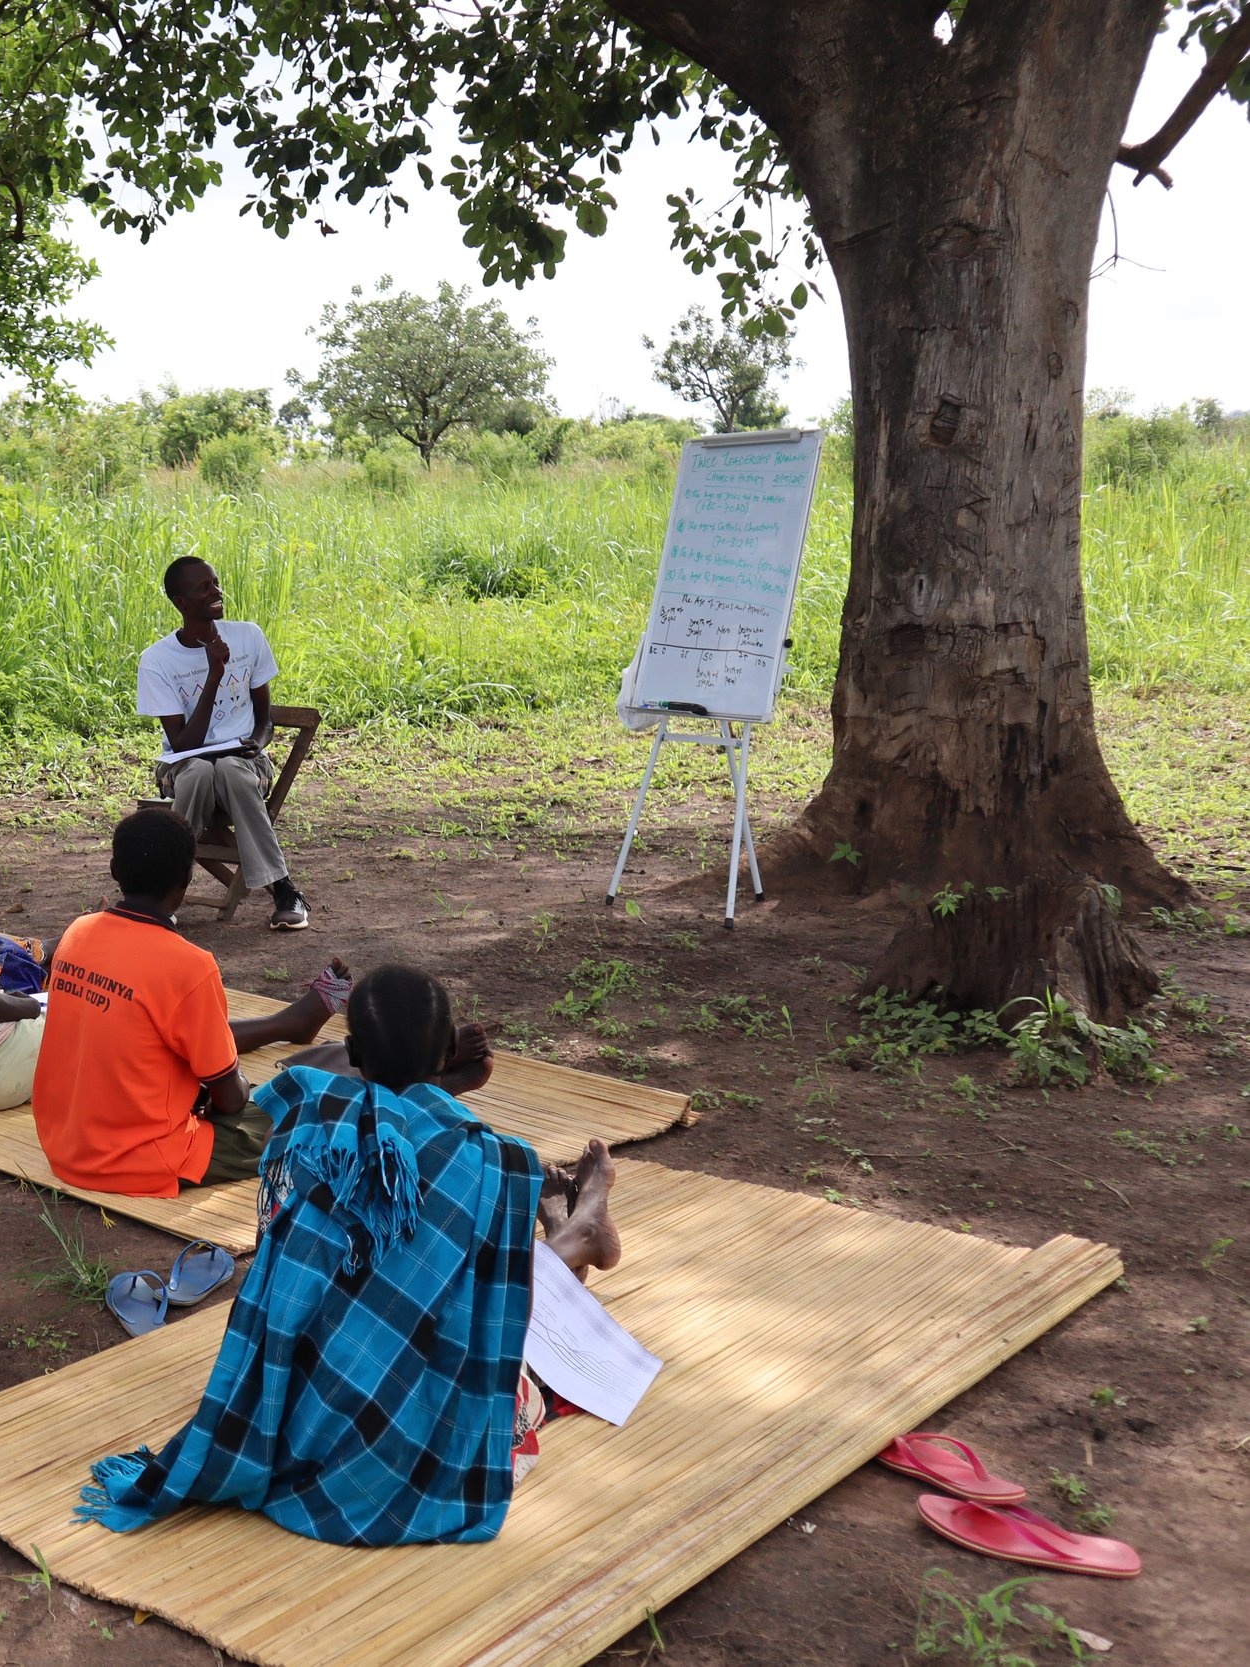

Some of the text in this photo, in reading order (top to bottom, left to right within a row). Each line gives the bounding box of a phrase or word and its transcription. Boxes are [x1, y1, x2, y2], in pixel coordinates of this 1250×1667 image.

[715, 600, 734, 611] Jesus
[702, 651, 714, 662] 50
[754, 658, 767, 668] 100
[86, 971, 134, 1002] AWINYA
[52, 977, 111, 1013] (BOLI CUP)
